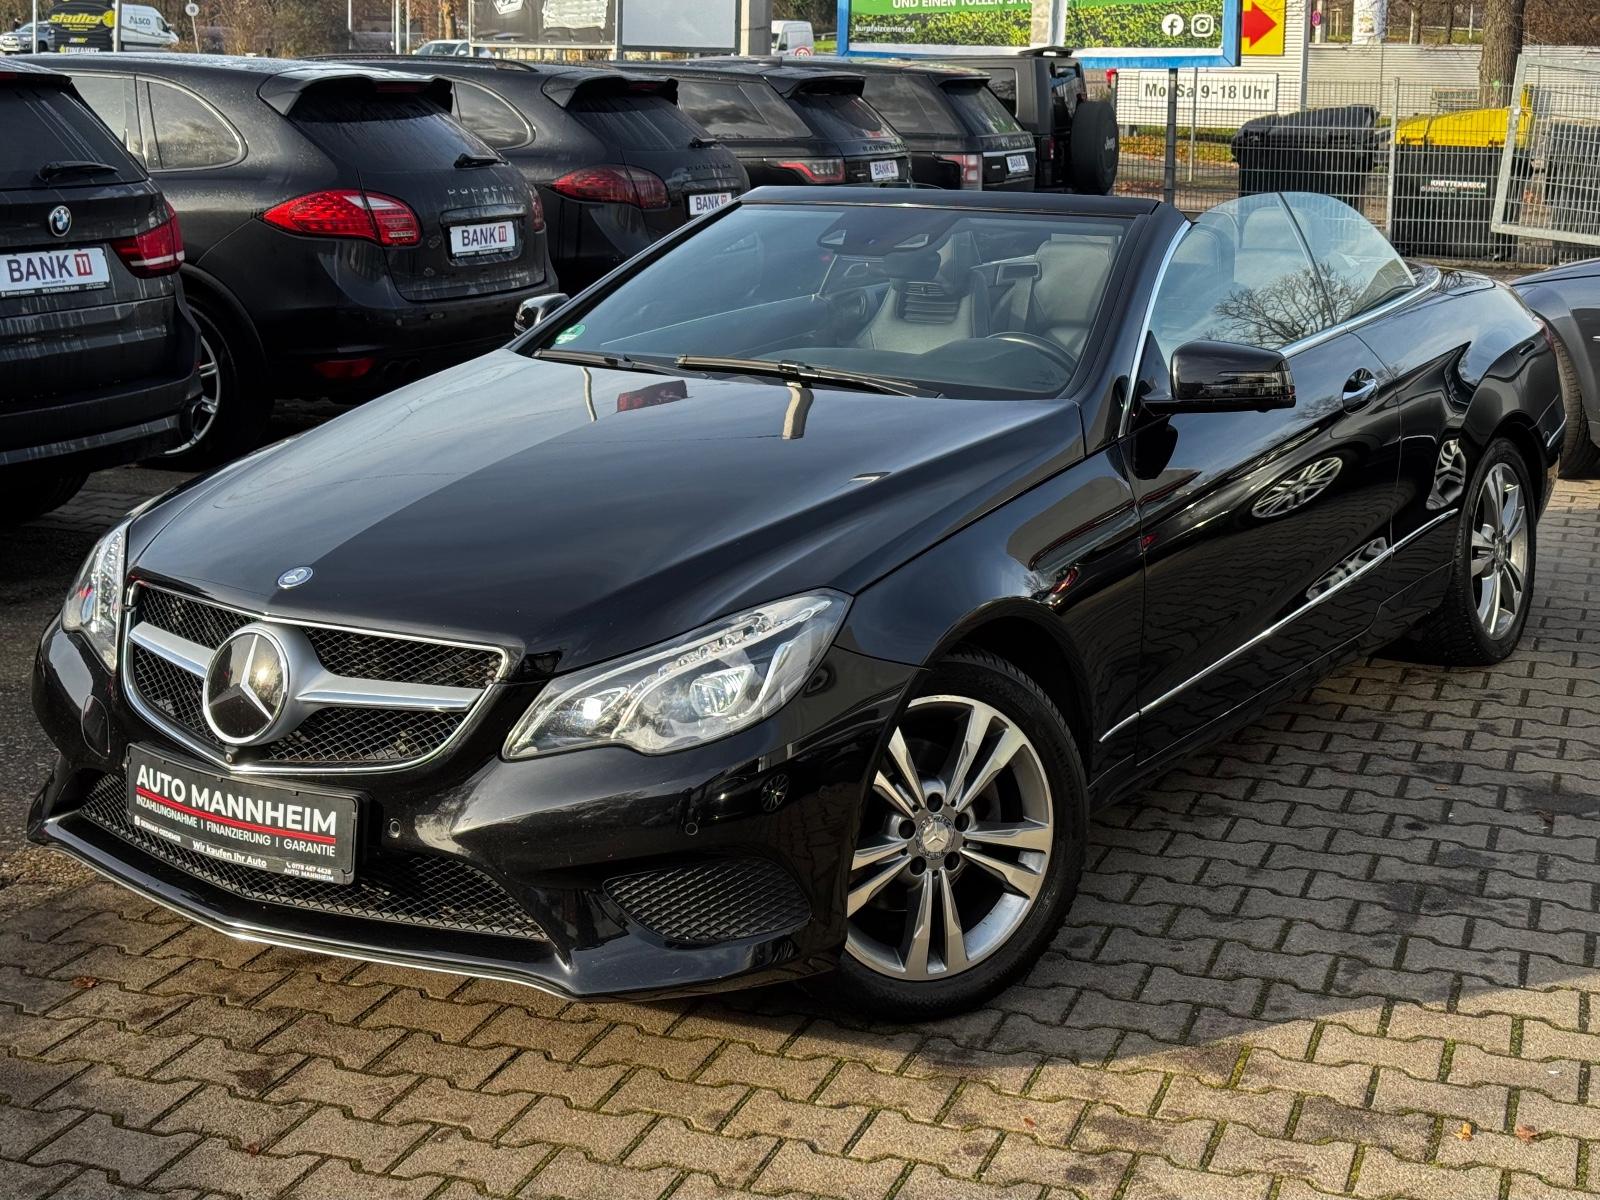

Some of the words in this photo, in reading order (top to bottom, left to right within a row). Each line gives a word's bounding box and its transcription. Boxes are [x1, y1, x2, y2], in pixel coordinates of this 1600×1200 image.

[893, 0, 919, 8] UND
[51, 12, 103, 24] stadler
[1201, 85, 1237, 99] 9-18
[1242, 85, 1269, 100] Uhr
[695, 195, 720, 211] BANK
[461, 226, 497, 247] BANK
[7, 254, 73, 283] BANK
[75, 254, 92, 276] 11
[136, 764, 187, 802] AUTO
[191, 783, 337, 836] MANNHEIM
[136, 794, 198, 828] INZAHLUNGNAHME
[206, 820, 271, 846] FINANZIERUNG
[283, 838, 336, 857] GARANTIE
[192, 840, 205, 853] Wir
[206, 844, 232, 860] kaufen
[234, 852, 246, 863] Ihr
[246, 855, 268, 869] Auto
